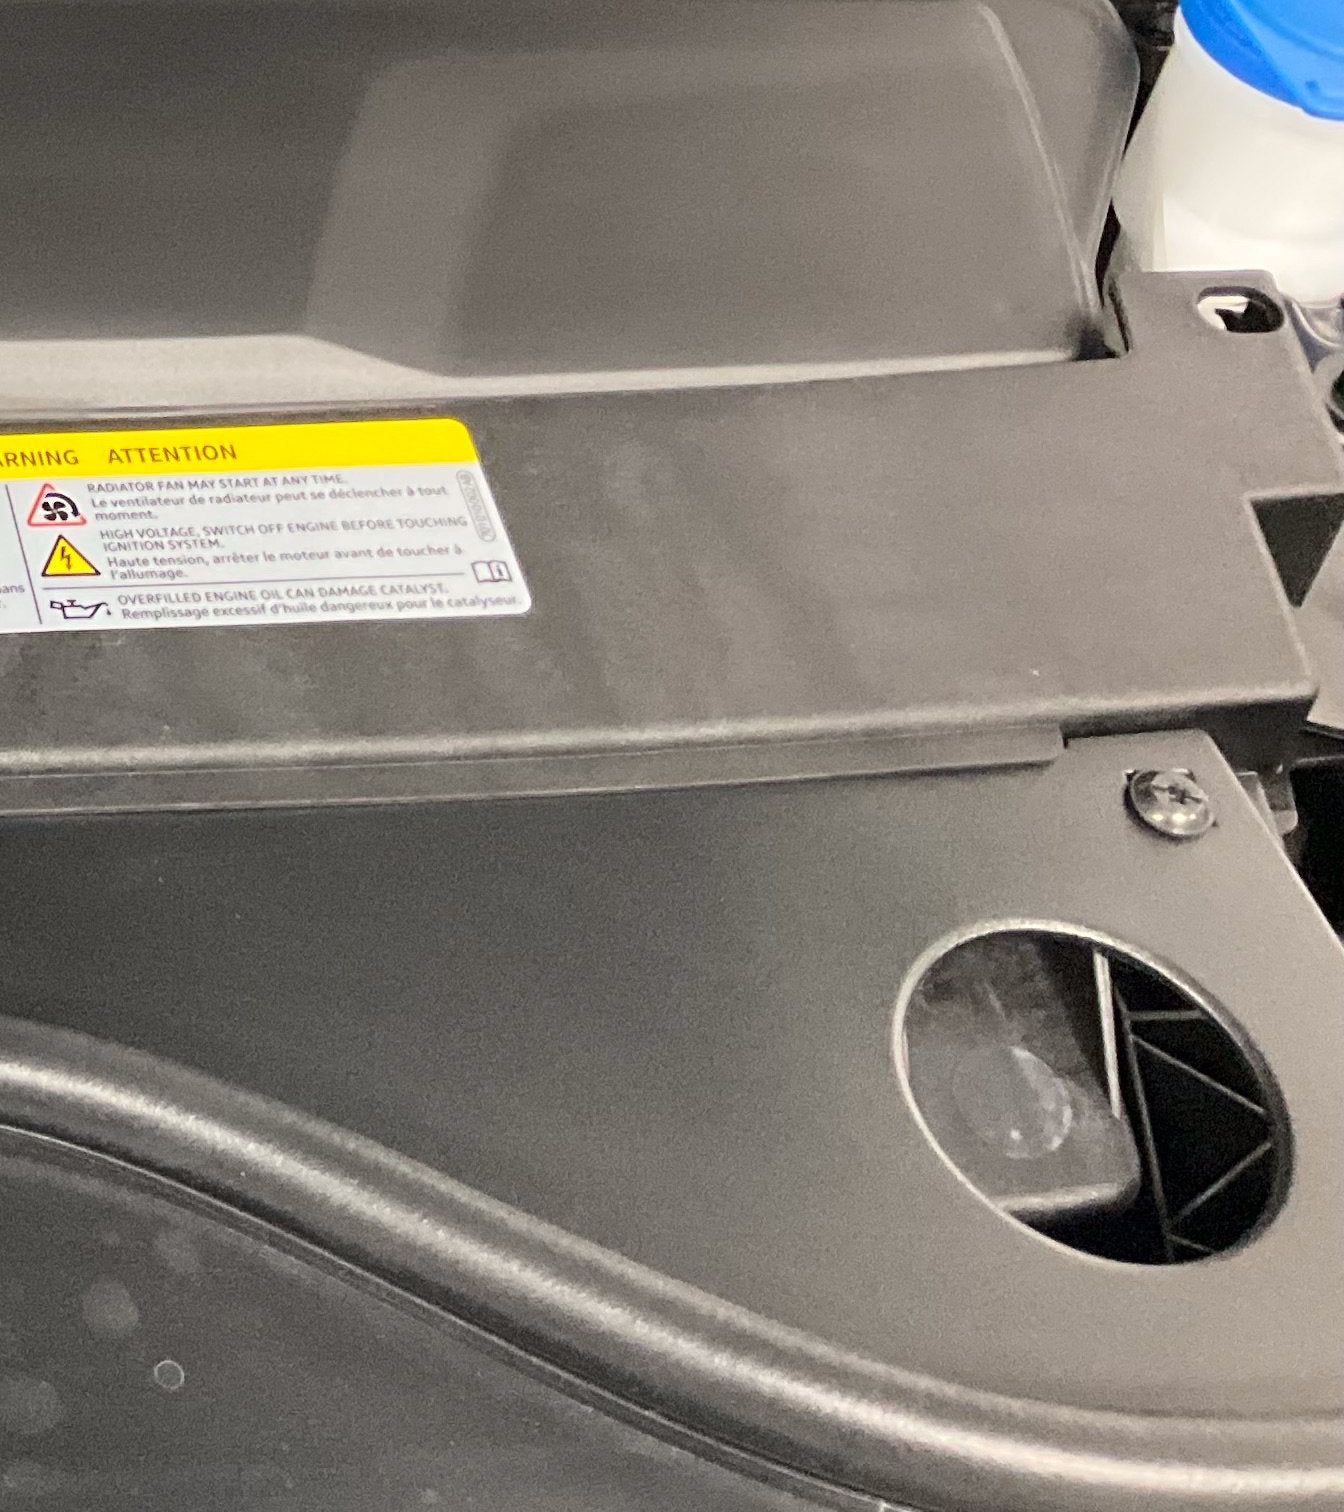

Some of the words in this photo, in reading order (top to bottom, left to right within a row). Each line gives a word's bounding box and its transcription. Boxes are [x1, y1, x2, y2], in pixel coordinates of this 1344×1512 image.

[108, 444, 238, 464] ATTENTION
[86, 481, 155, 494] RADIATOR
[157, 480, 185, 492] FAN
[187, 479, 216, 491] MAY
[218, 477, 259, 489] START
[263, 476, 278, 487] AT
[282, 475, 309, 486] ANY
[90, 497, 108, 509] Le
[110, 496, 186, 508] ventilateur
[188, 494, 206, 506] de
[208, 493, 272, 505] radiateur
[275, 491, 308, 504] peut
[310, 491, 326, 501] se
[328, 487, 403, 500] déclencher
[417, 486, 449, 497] tout
[99, 528, 135, 540] HIGH
[202, 524, 256, 537] SWITCH
[257, 523, 284, 535] OFF
[286, 520, 339, 534] ENGINE
[341, 519, 396, 531] BEFORE
[396, 516, 468, 529] TOUCHING
[103, 540, 166, 553] IGNITION
[106, 556, 151, 567] Haute
[262, 551, 277, 563] le
[279, 550, 330, 562] moteur
[334, 548, 375, 560] avant
[376, 546, 394, 559] de
[396, 544, 450, 557] toucher
[117, 592, 203, 606] OVERFILLED
[204, 590, 258, 603] ENGINE
[260, 589, 284, 601] OIL
[285, 588, 316, 600] CAN
[317, 585, 378, 599] DAMAGE
[121, 606, 210, 622] Remplissage
[212, 603, 267, 618] excessif
[319, 600, 395, 614] dangereux
[396, 599, 428, 613] pour
[430, 596, 445, 609] le
